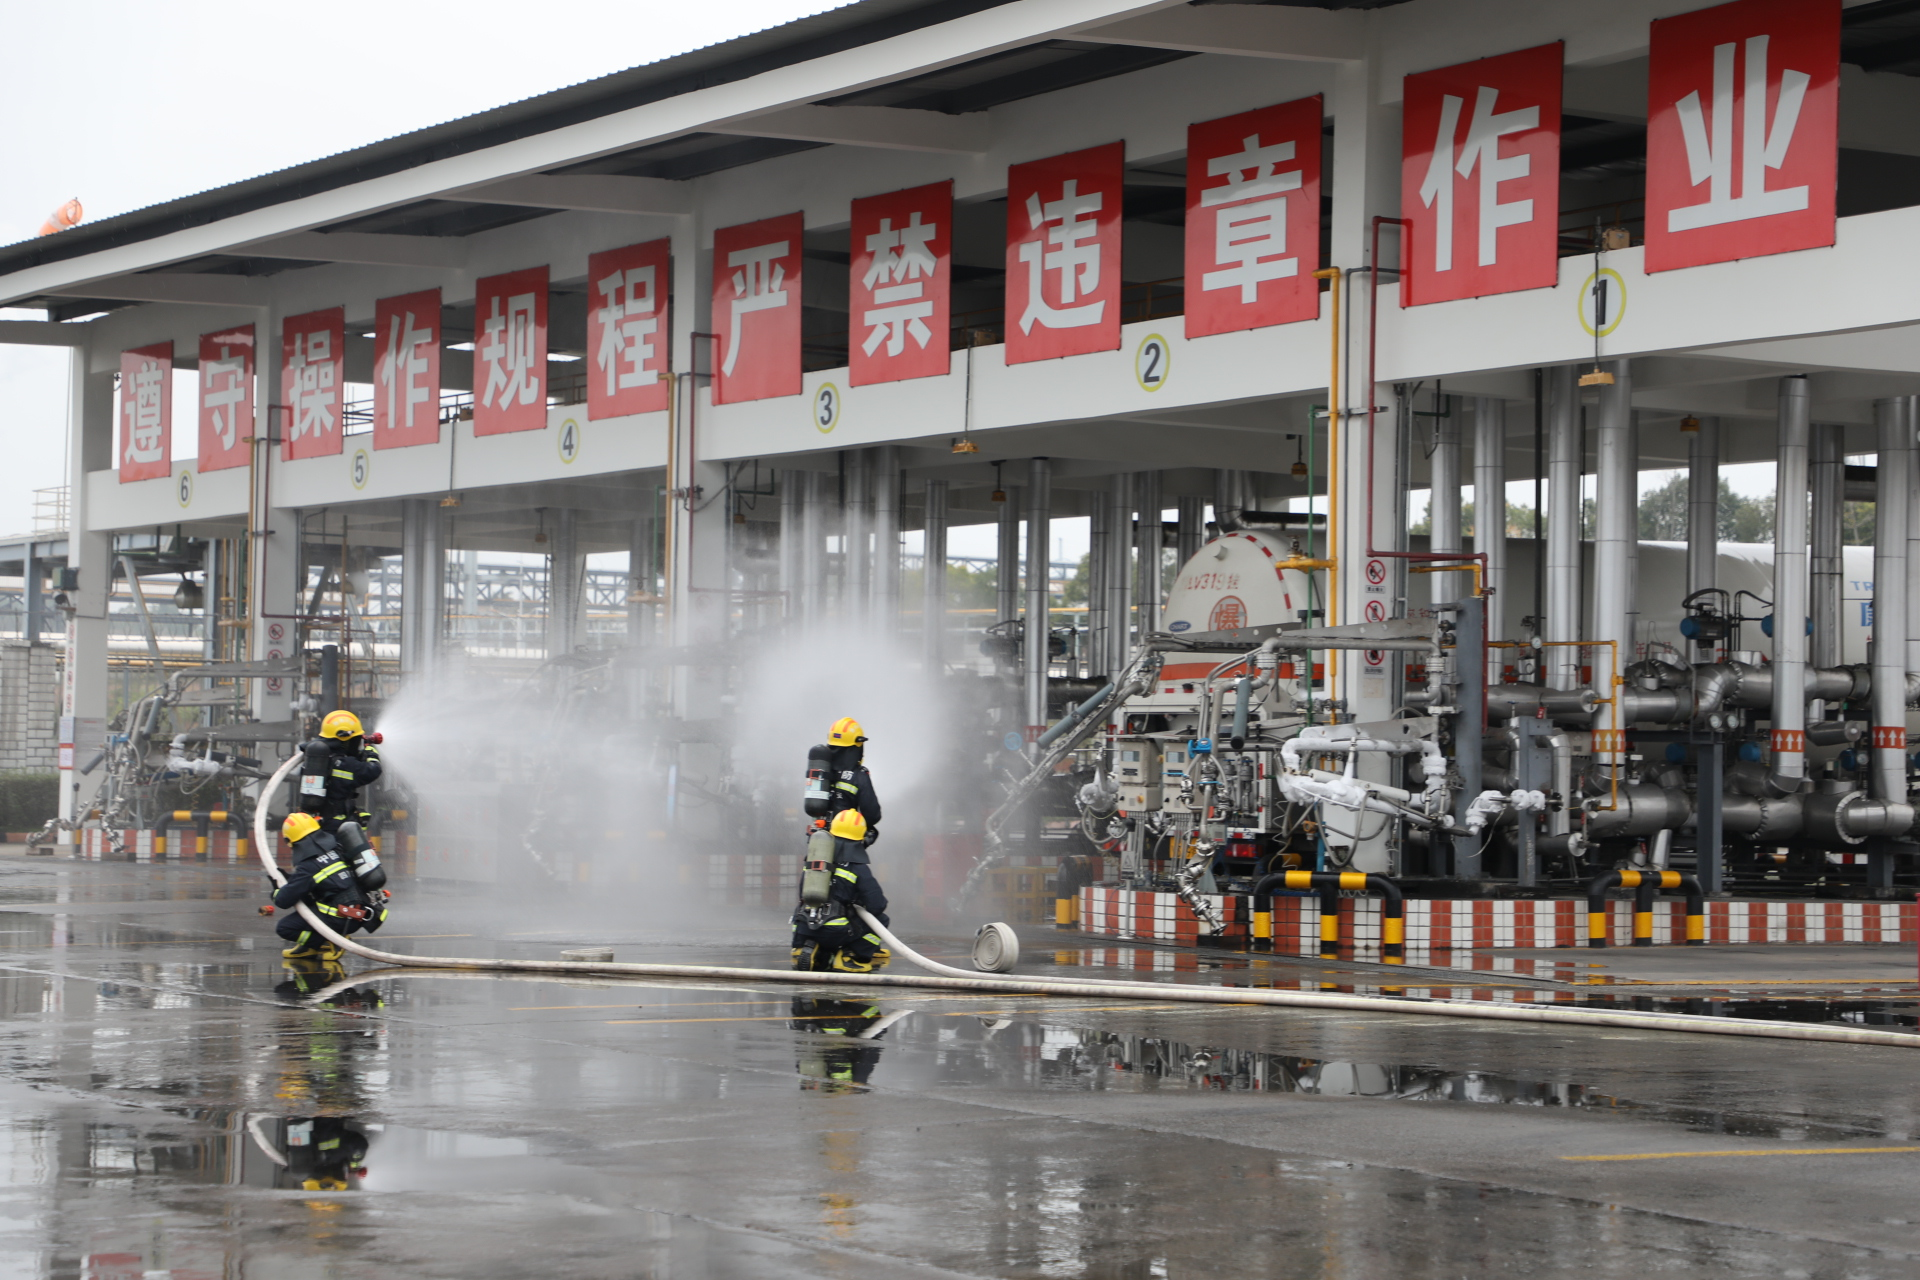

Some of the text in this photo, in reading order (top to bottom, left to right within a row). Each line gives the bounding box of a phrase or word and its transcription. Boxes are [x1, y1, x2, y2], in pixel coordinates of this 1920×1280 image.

[123, 34, 1812, 465] 遵 守 操 作 规 程 严 禁 违 章 作 业
[1592, 279, 1608, 326] 1
[1142, 342, 1161, 384] 2
[819, 389, 833, 426] 3
[562, 424, 575, 457] 4
[354, 455, 365, 483] 5
[180, 474, 190, 503] 6
